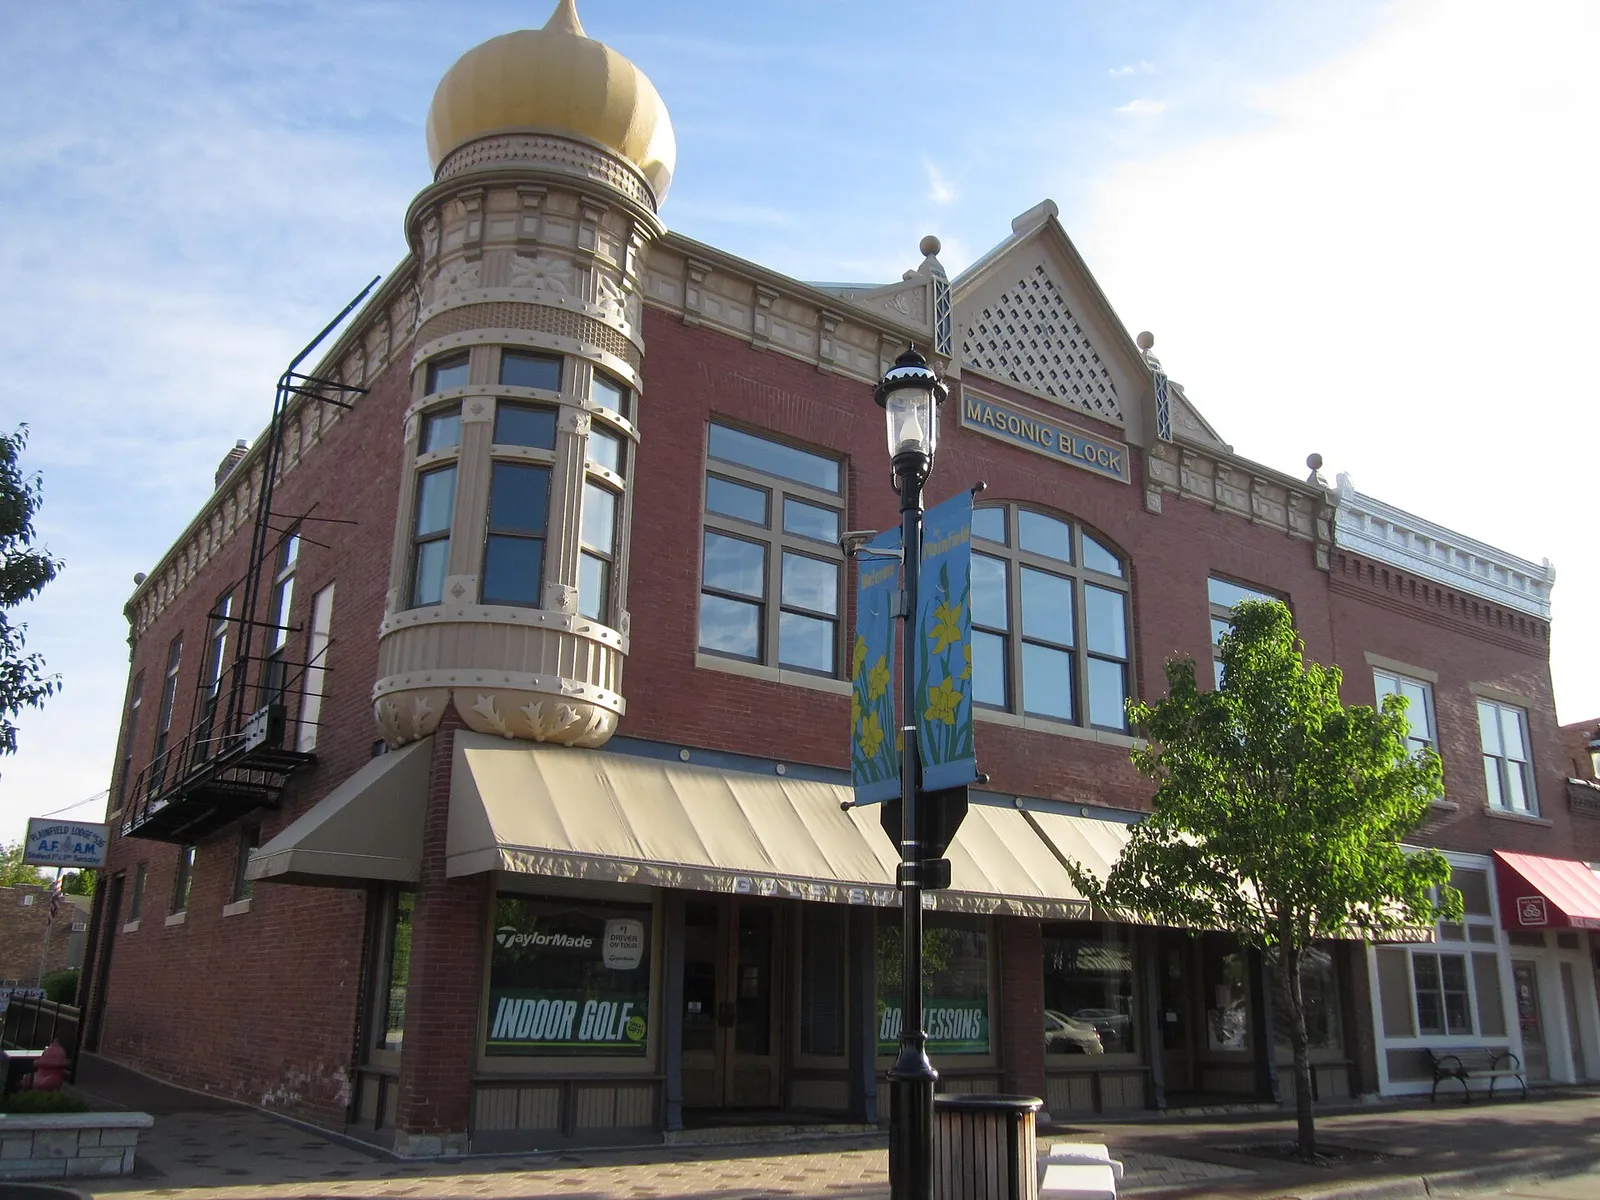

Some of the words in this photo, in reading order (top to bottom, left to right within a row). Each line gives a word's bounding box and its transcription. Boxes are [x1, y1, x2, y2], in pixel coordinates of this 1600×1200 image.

[966, 399, 1053, 447] MASONIC
[1058, 433, 1121, 472] BLOCK
[30, 825, 69, 842] PLAINFIELD
[71, 826, 93, 840] LODGE
[496, 925, 592, 948] TaylorMade
[610, 934, 638, 942] DRIVER
[490, 997, 577, 1039] INDOOR
[578, 999, 634, 1041] GOLF
